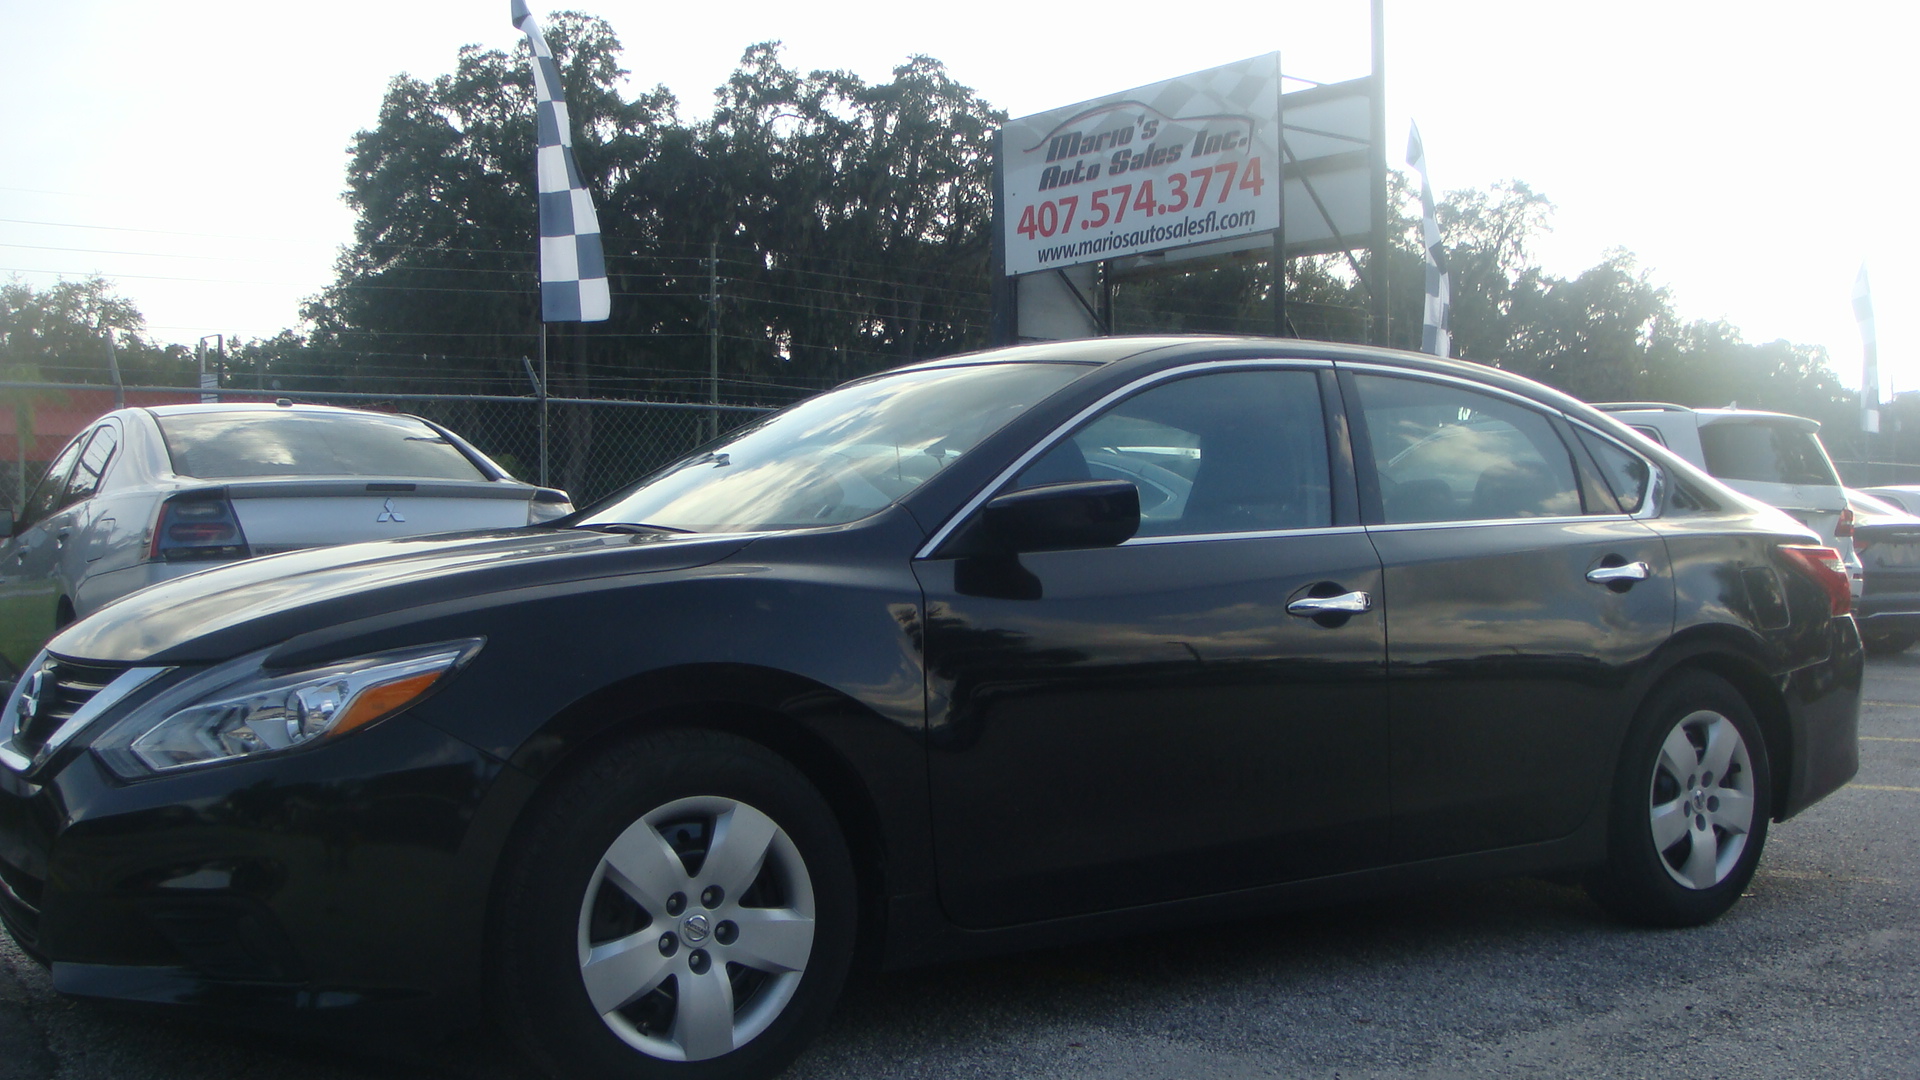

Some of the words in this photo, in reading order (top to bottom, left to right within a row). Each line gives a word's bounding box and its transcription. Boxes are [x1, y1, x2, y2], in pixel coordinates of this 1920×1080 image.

[1038, 160, 1100, 192] Auto
[1108, 143, 1183, 176] Sales
[1191, 129, 1248, 158] Inc.
[1045, 114, 1159, 163] Mario's
[1017, 157, 1265, 240] 407.574.3774
[1037, 209, 1256, 263] www.mariosautosalesfl.com
